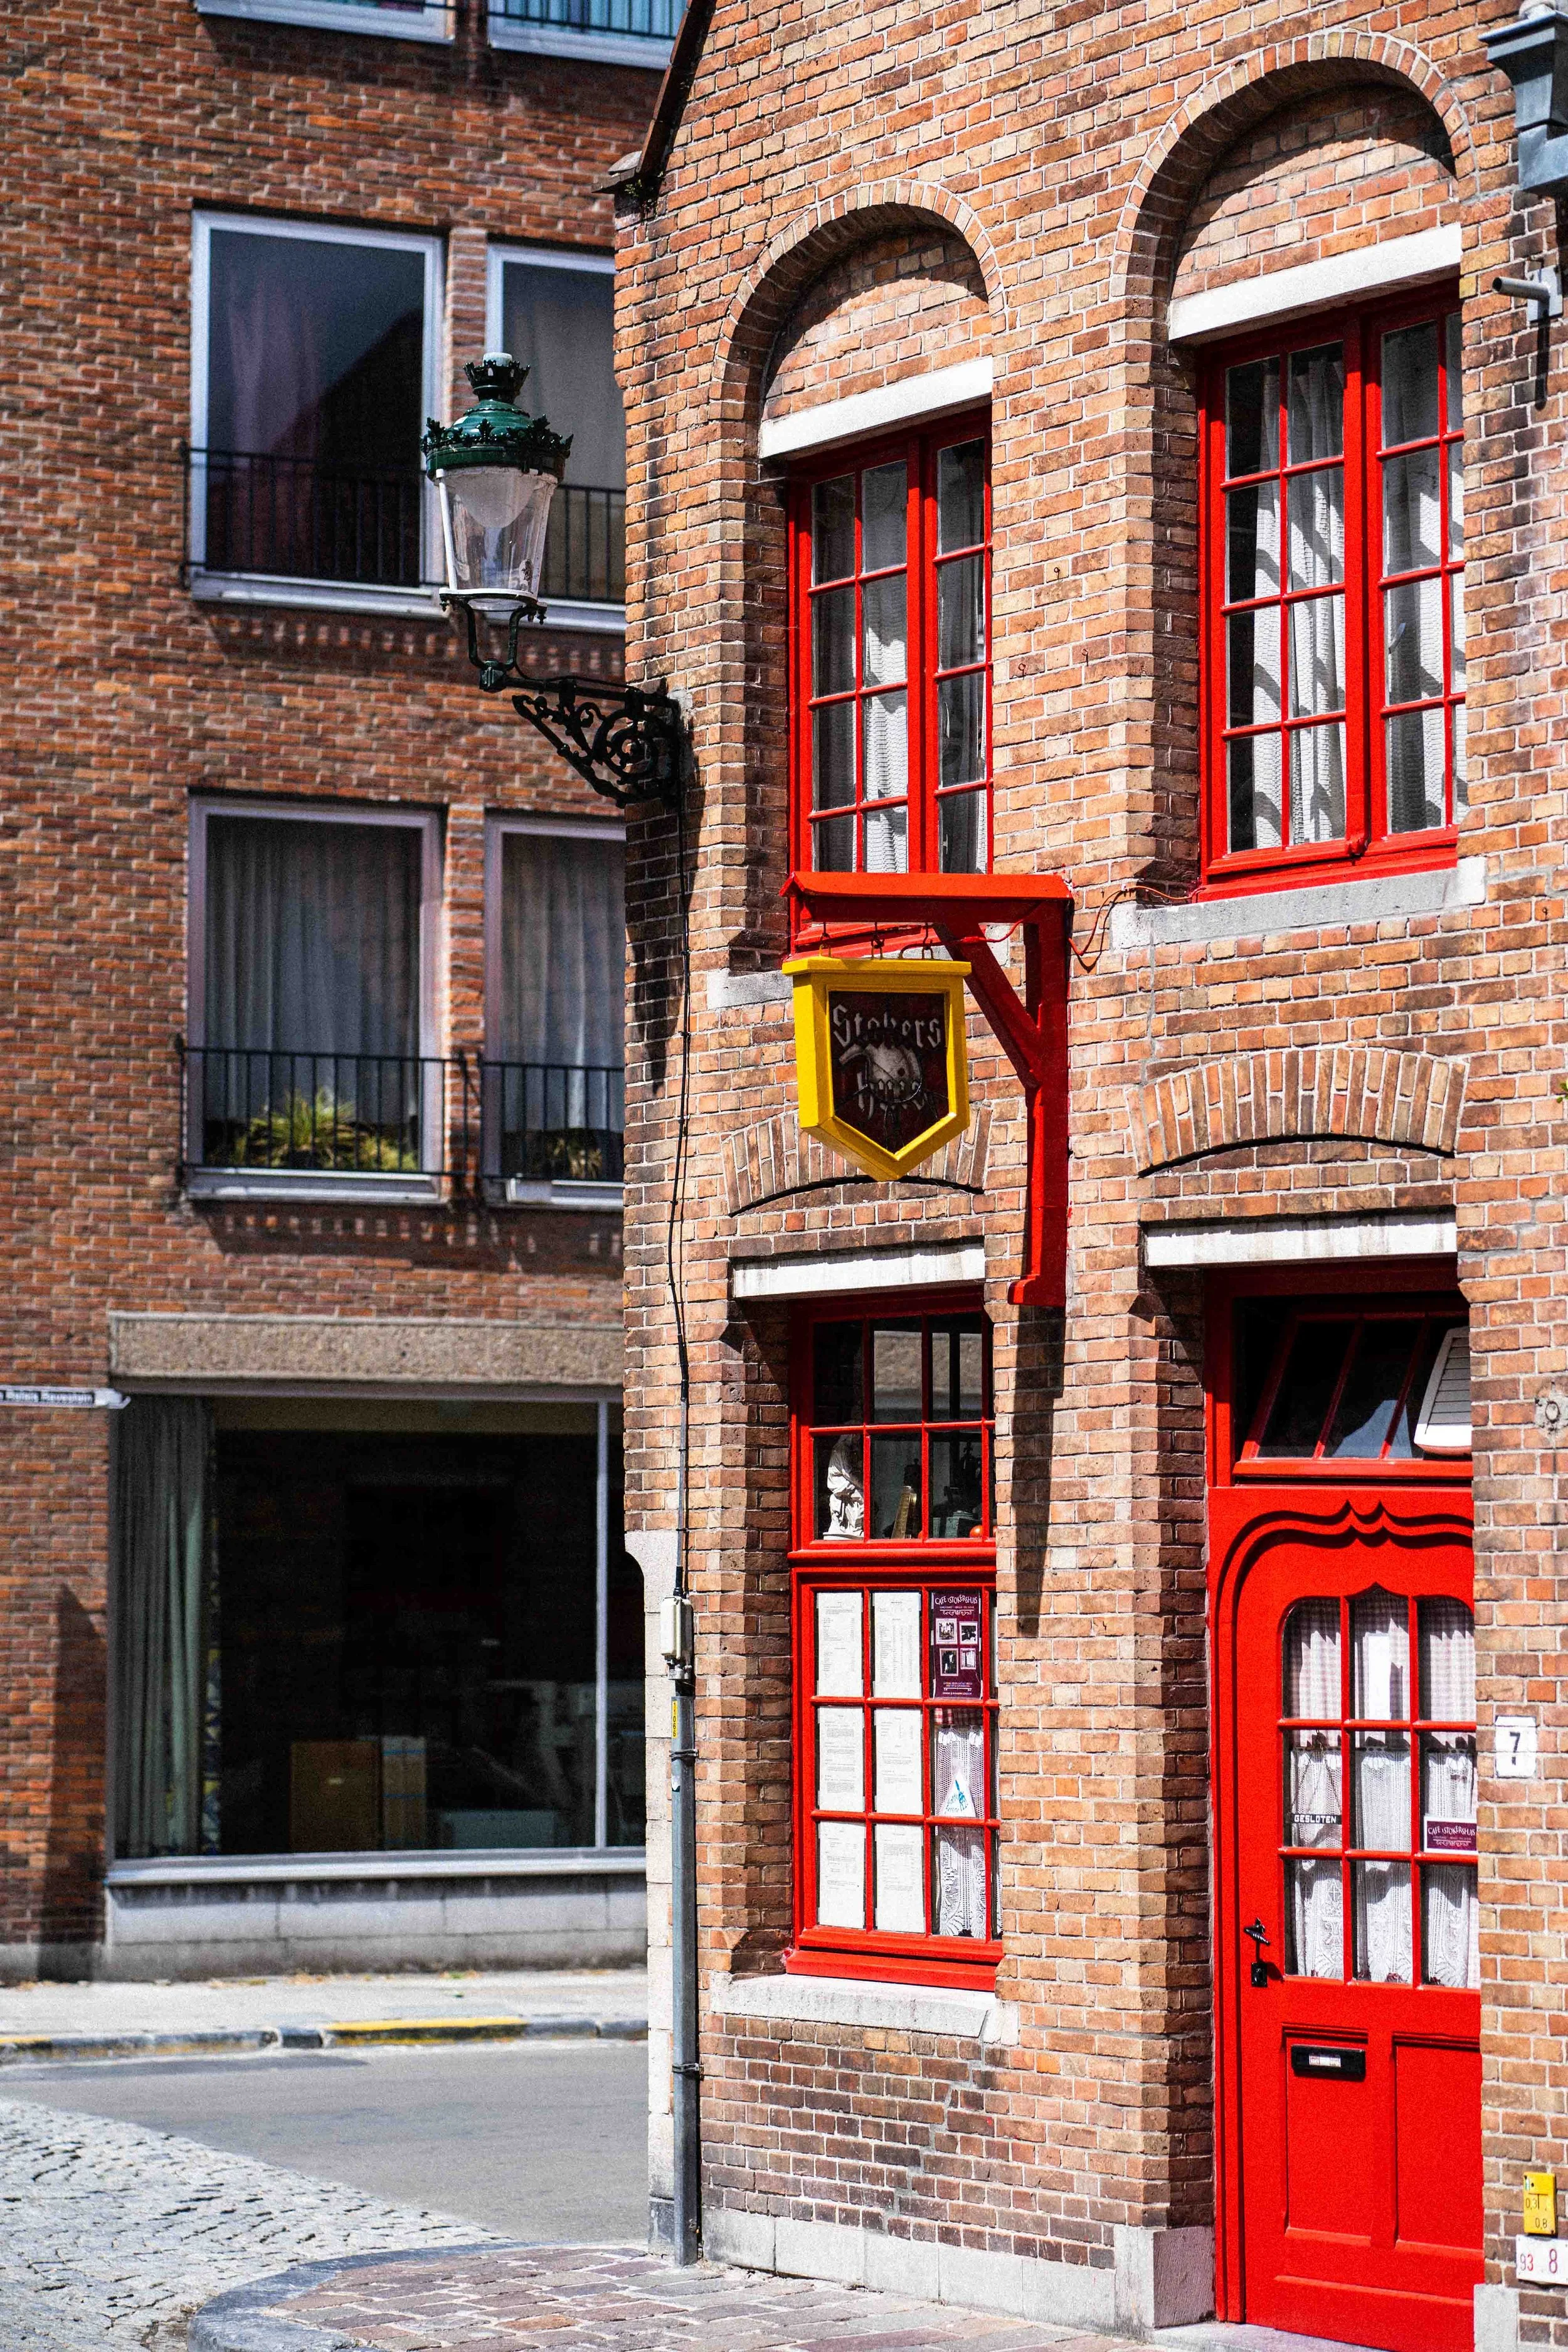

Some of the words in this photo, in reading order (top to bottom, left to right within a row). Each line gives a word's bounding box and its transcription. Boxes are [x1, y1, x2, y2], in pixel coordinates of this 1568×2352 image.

[1509, 1731, 1521, 1766] 7
[1293, 1814, 1337, 1824] GESLOTEN
[1535, 2217, 1547, 2230] 0,8
[1520, 2252, 1534, 2272] 93
[1549, 2249, 1558, 2274] 8
